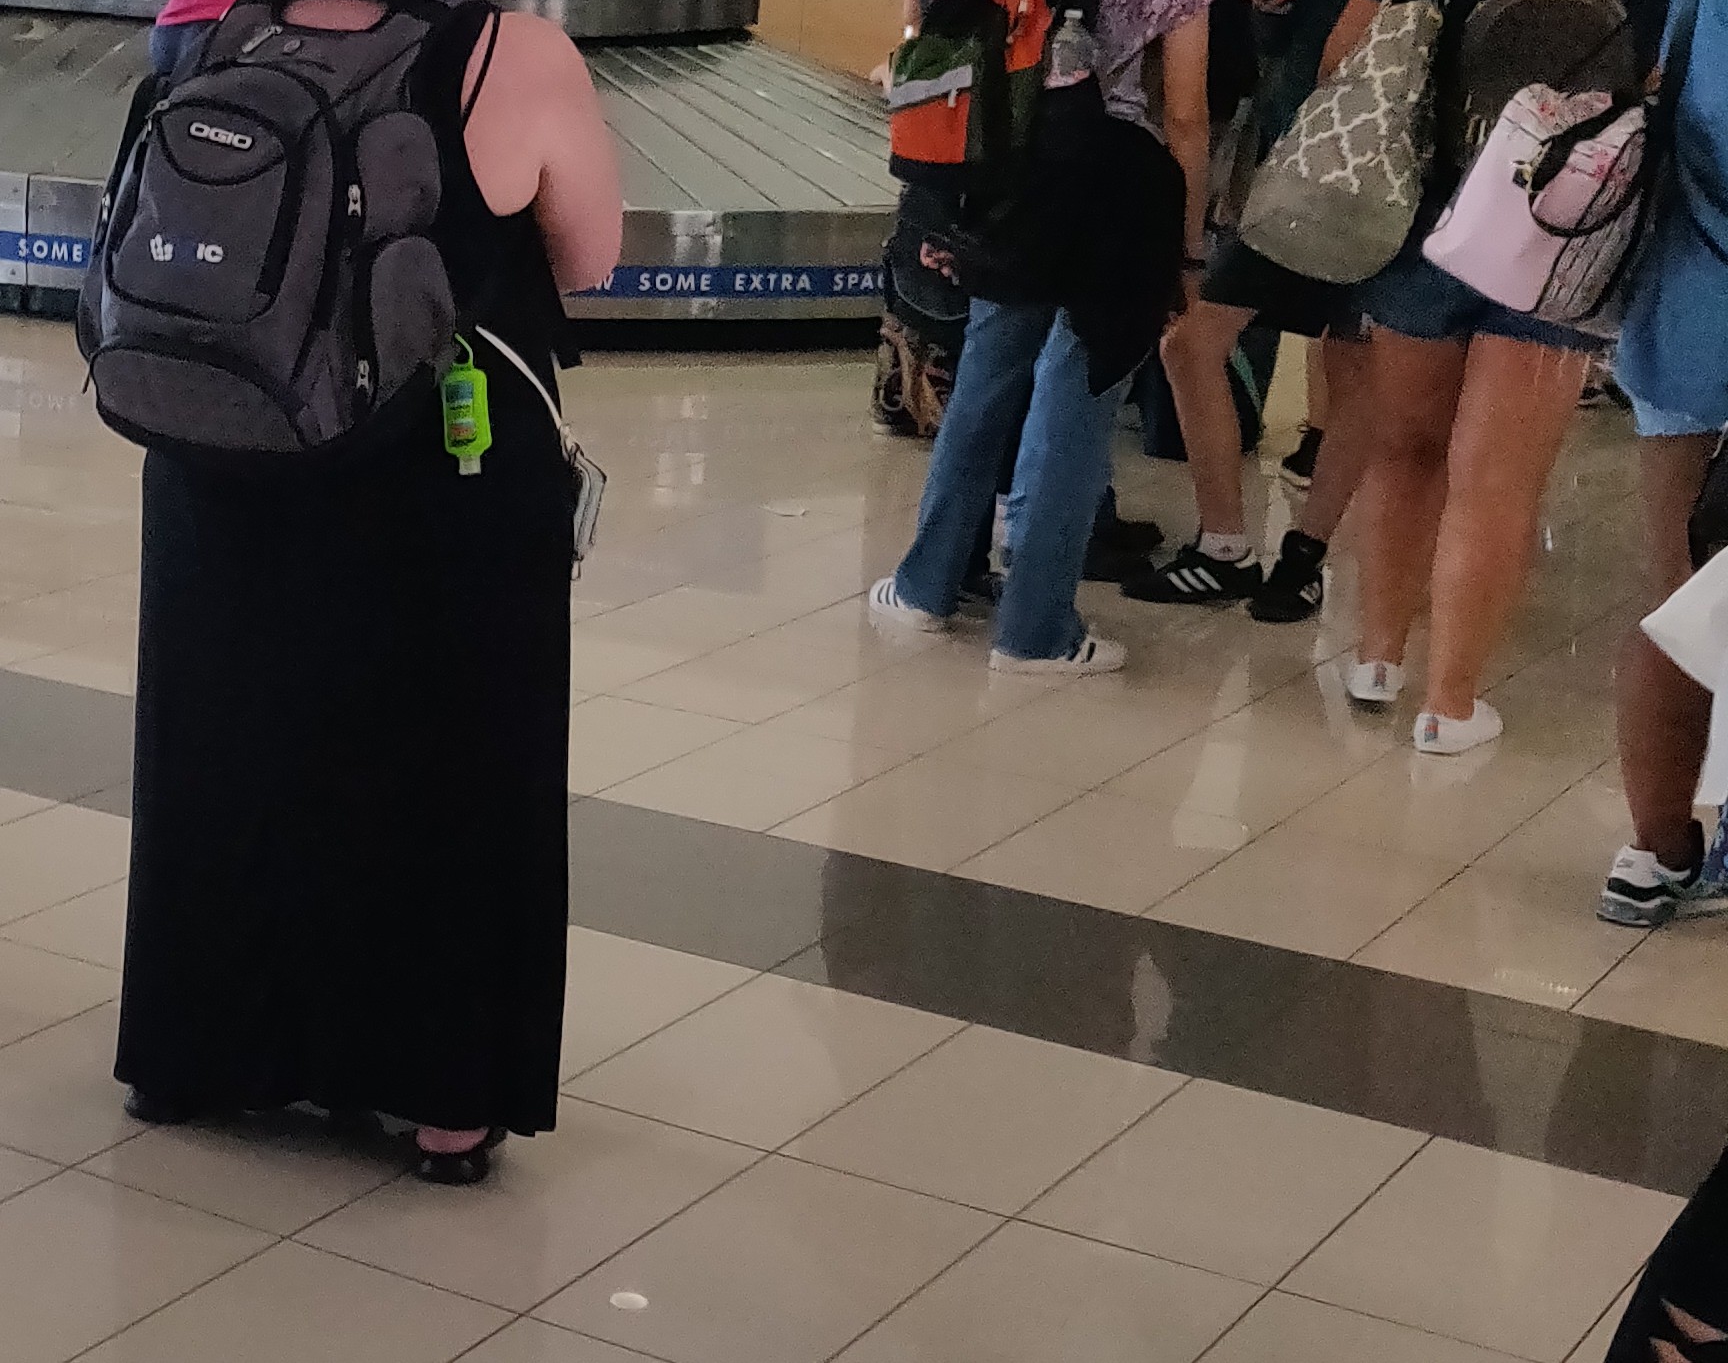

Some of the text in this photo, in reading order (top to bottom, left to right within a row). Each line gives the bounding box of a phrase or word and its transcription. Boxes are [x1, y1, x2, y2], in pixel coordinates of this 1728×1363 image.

[190, 121, 254, 150] OGIO
[17, 238, 84, 263] SOME
[637, 273, 712, 292] SOME
[734, 273, 812, 292] EXTRA
